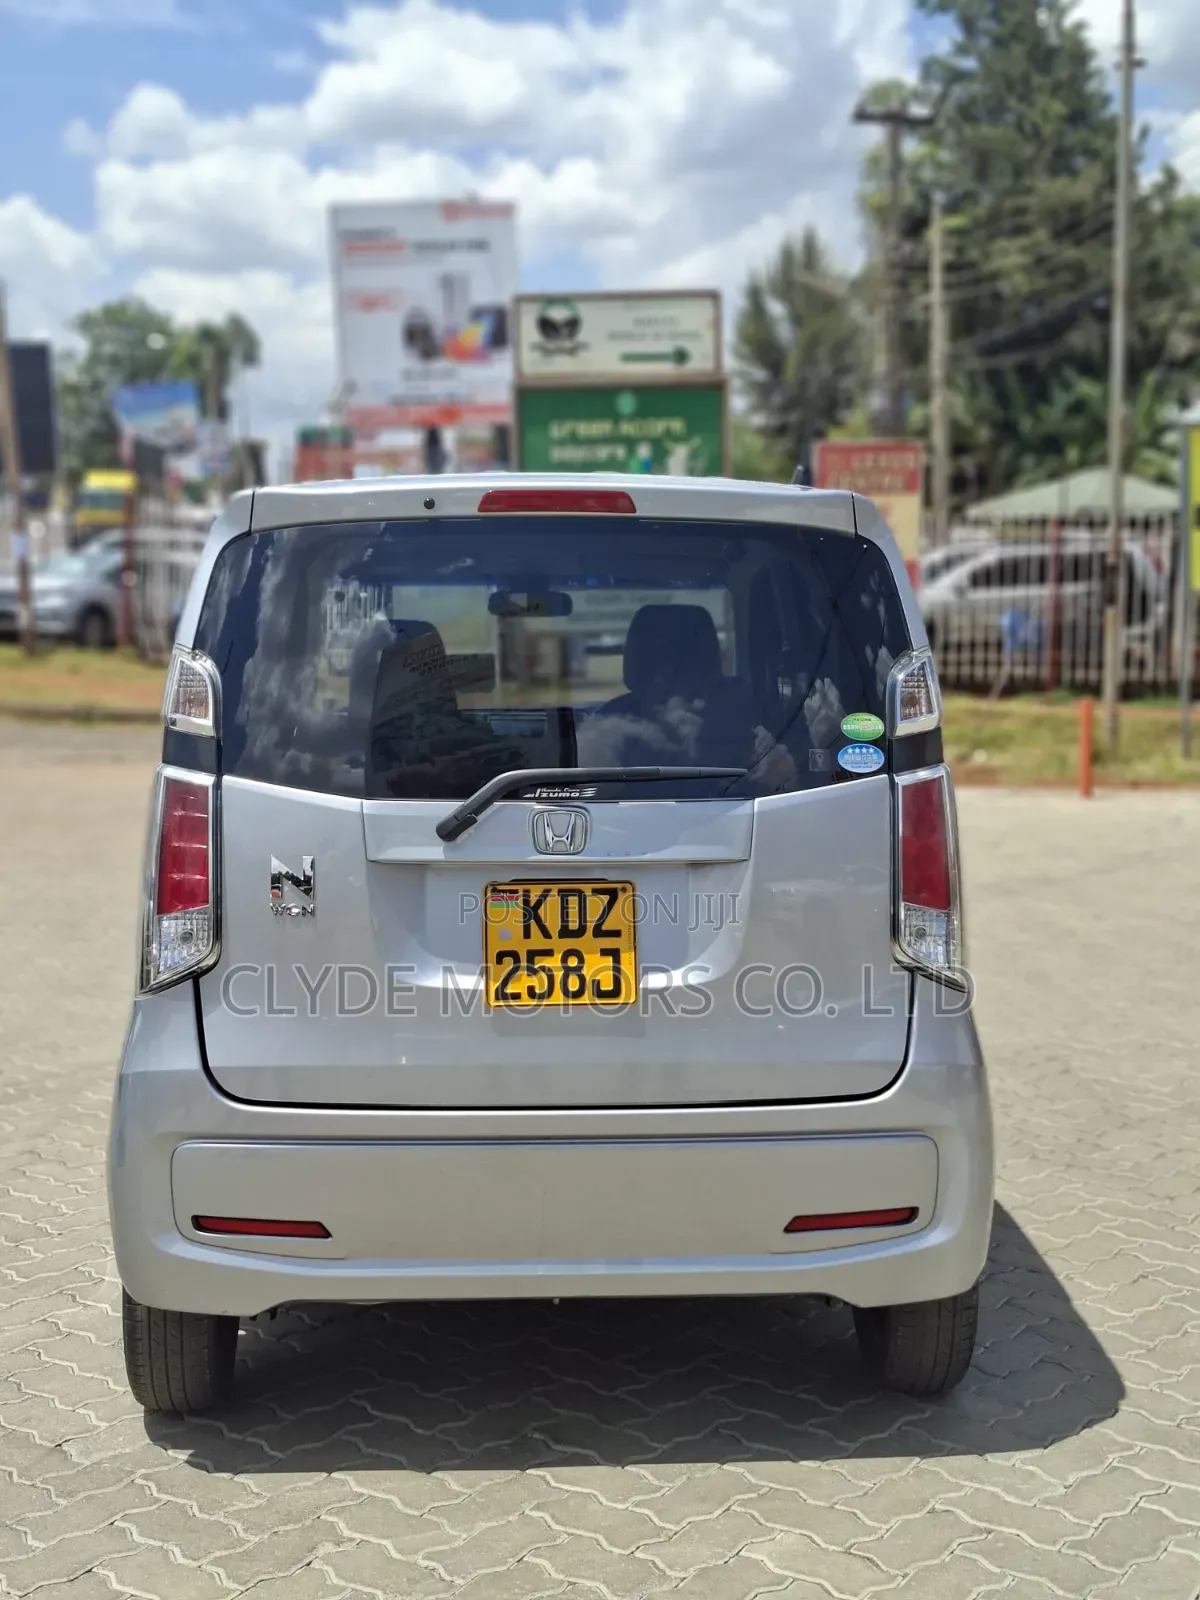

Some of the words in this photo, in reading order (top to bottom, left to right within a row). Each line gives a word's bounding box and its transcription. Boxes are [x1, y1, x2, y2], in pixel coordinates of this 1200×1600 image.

[270, 854, 315, 900] N
[522, 888, 622, 939] KDZ
[494, 948, 622, 1001] 258J
